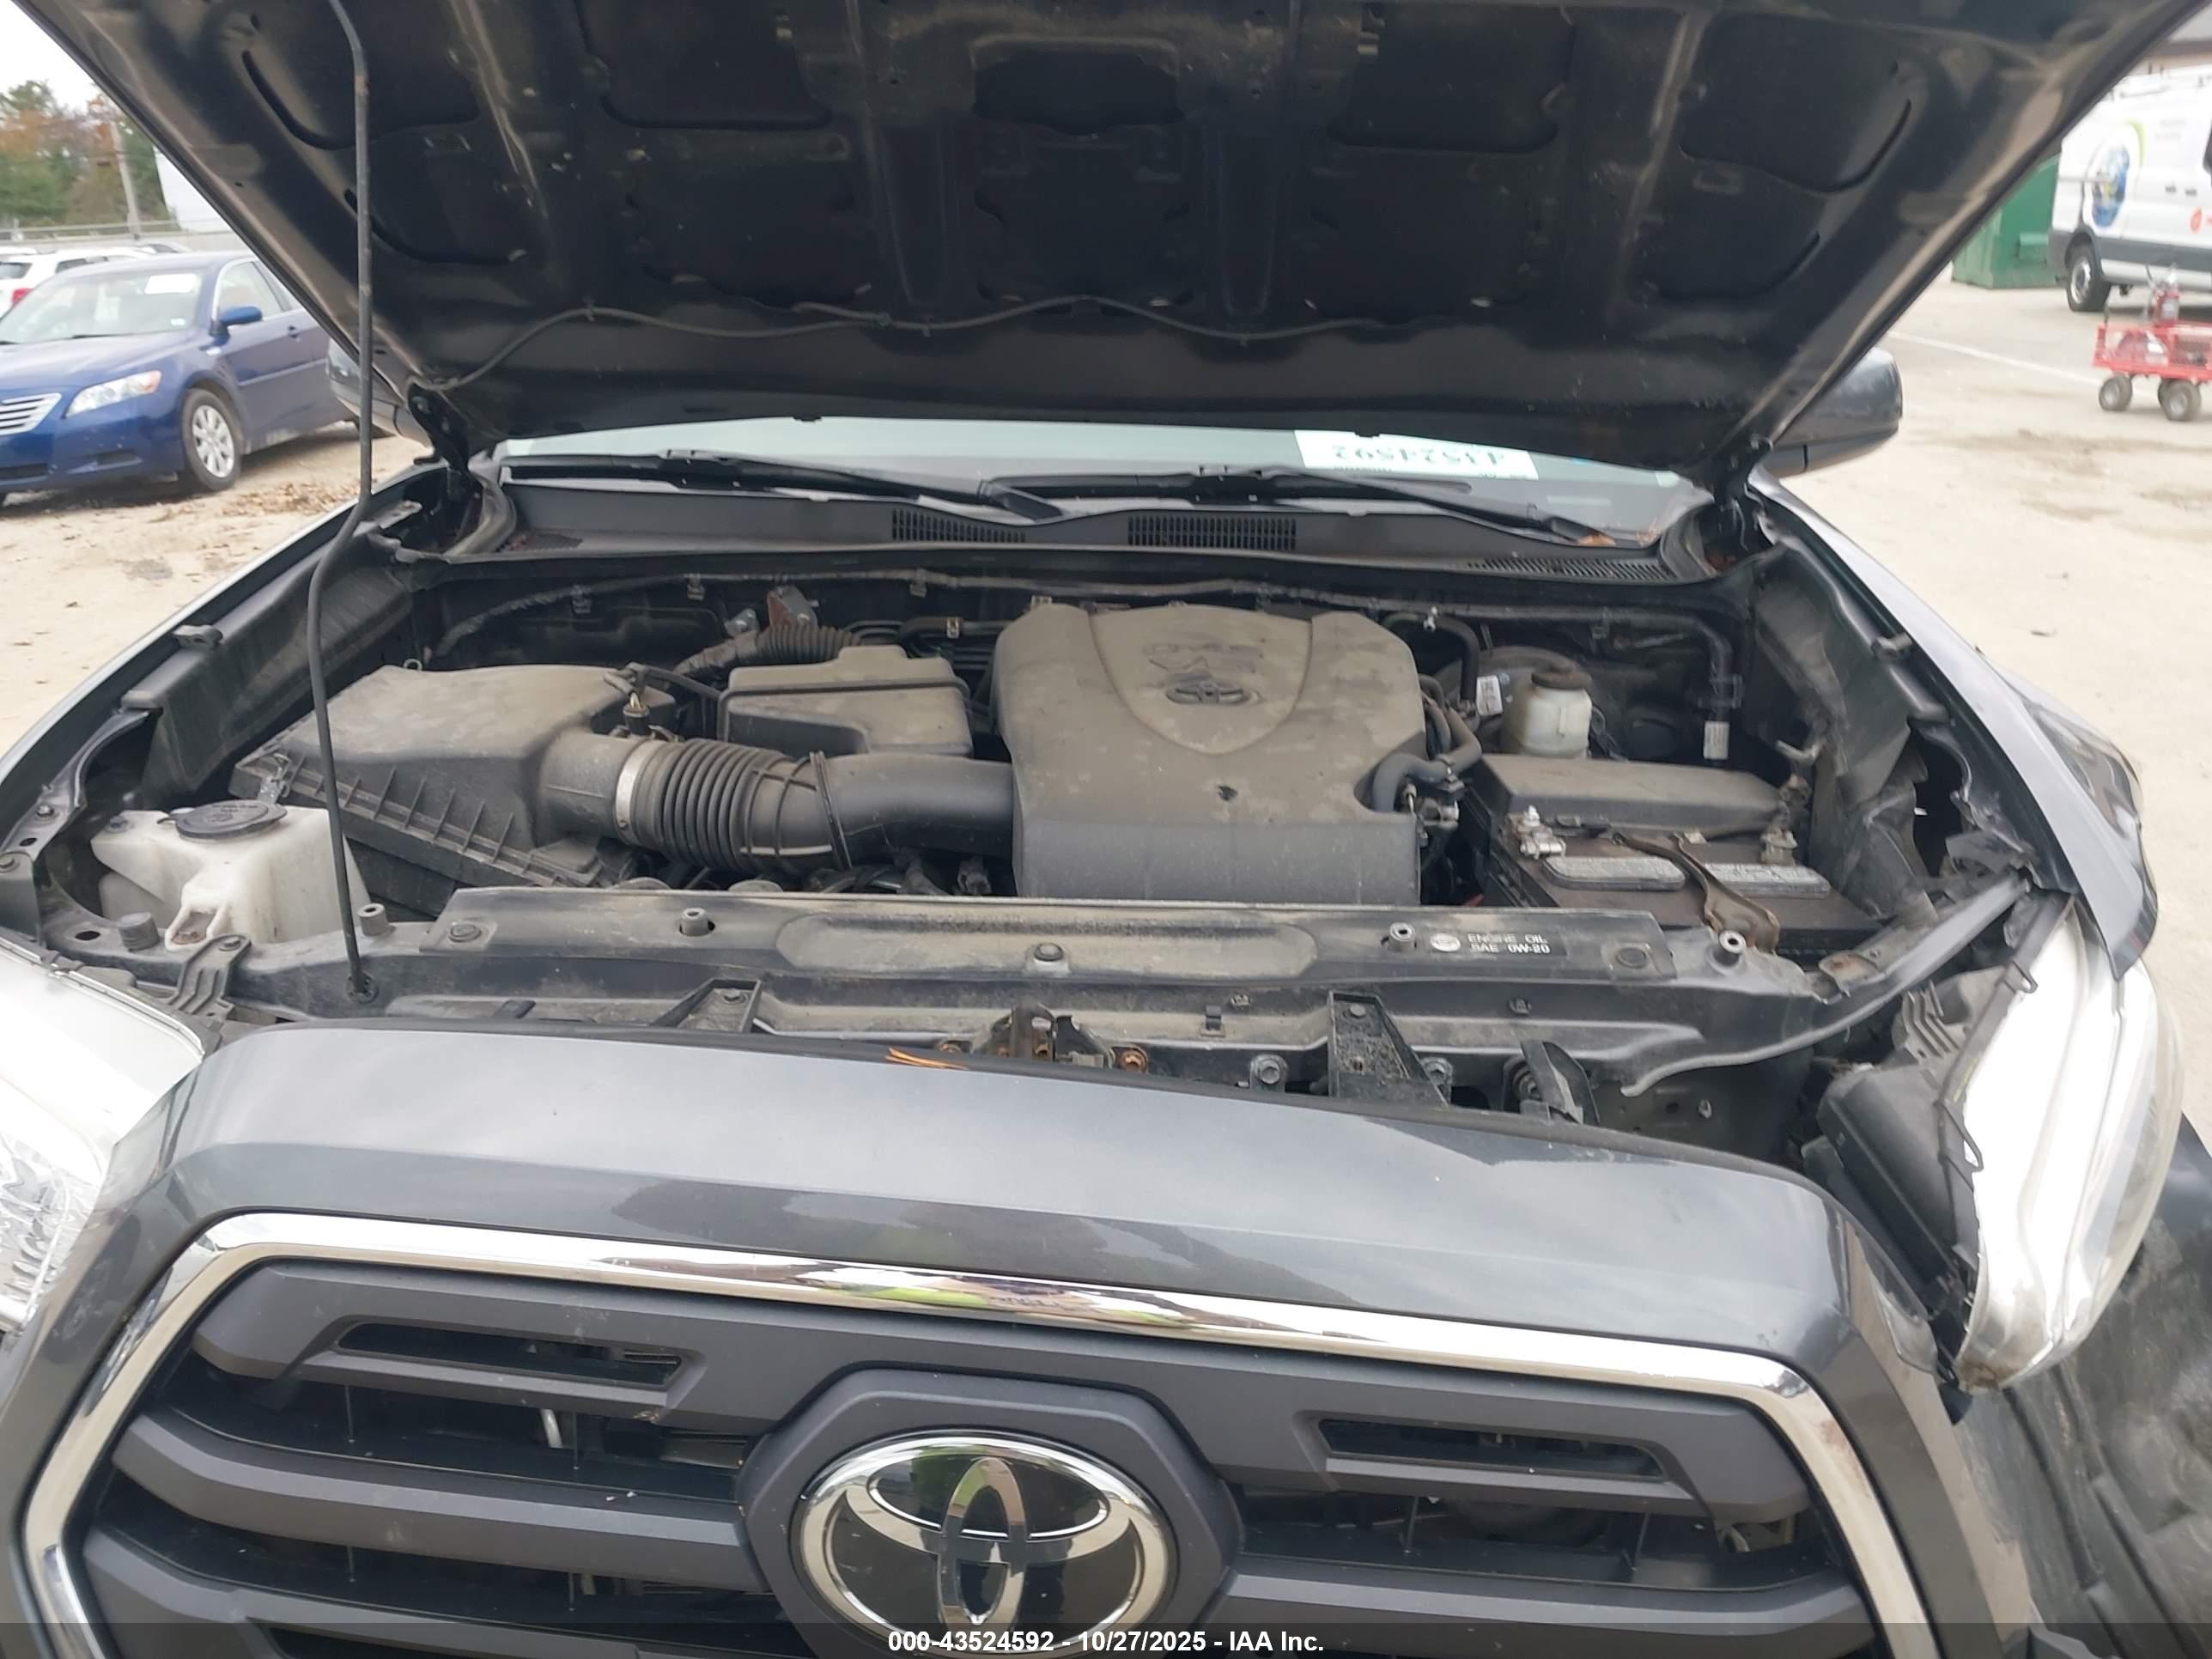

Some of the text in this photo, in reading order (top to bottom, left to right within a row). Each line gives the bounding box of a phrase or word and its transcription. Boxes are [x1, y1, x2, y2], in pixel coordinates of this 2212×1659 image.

[1468, 933, 1548, 944] ENGINE OIL
[1470, 944, 1551, 954] SAE 0W-20
